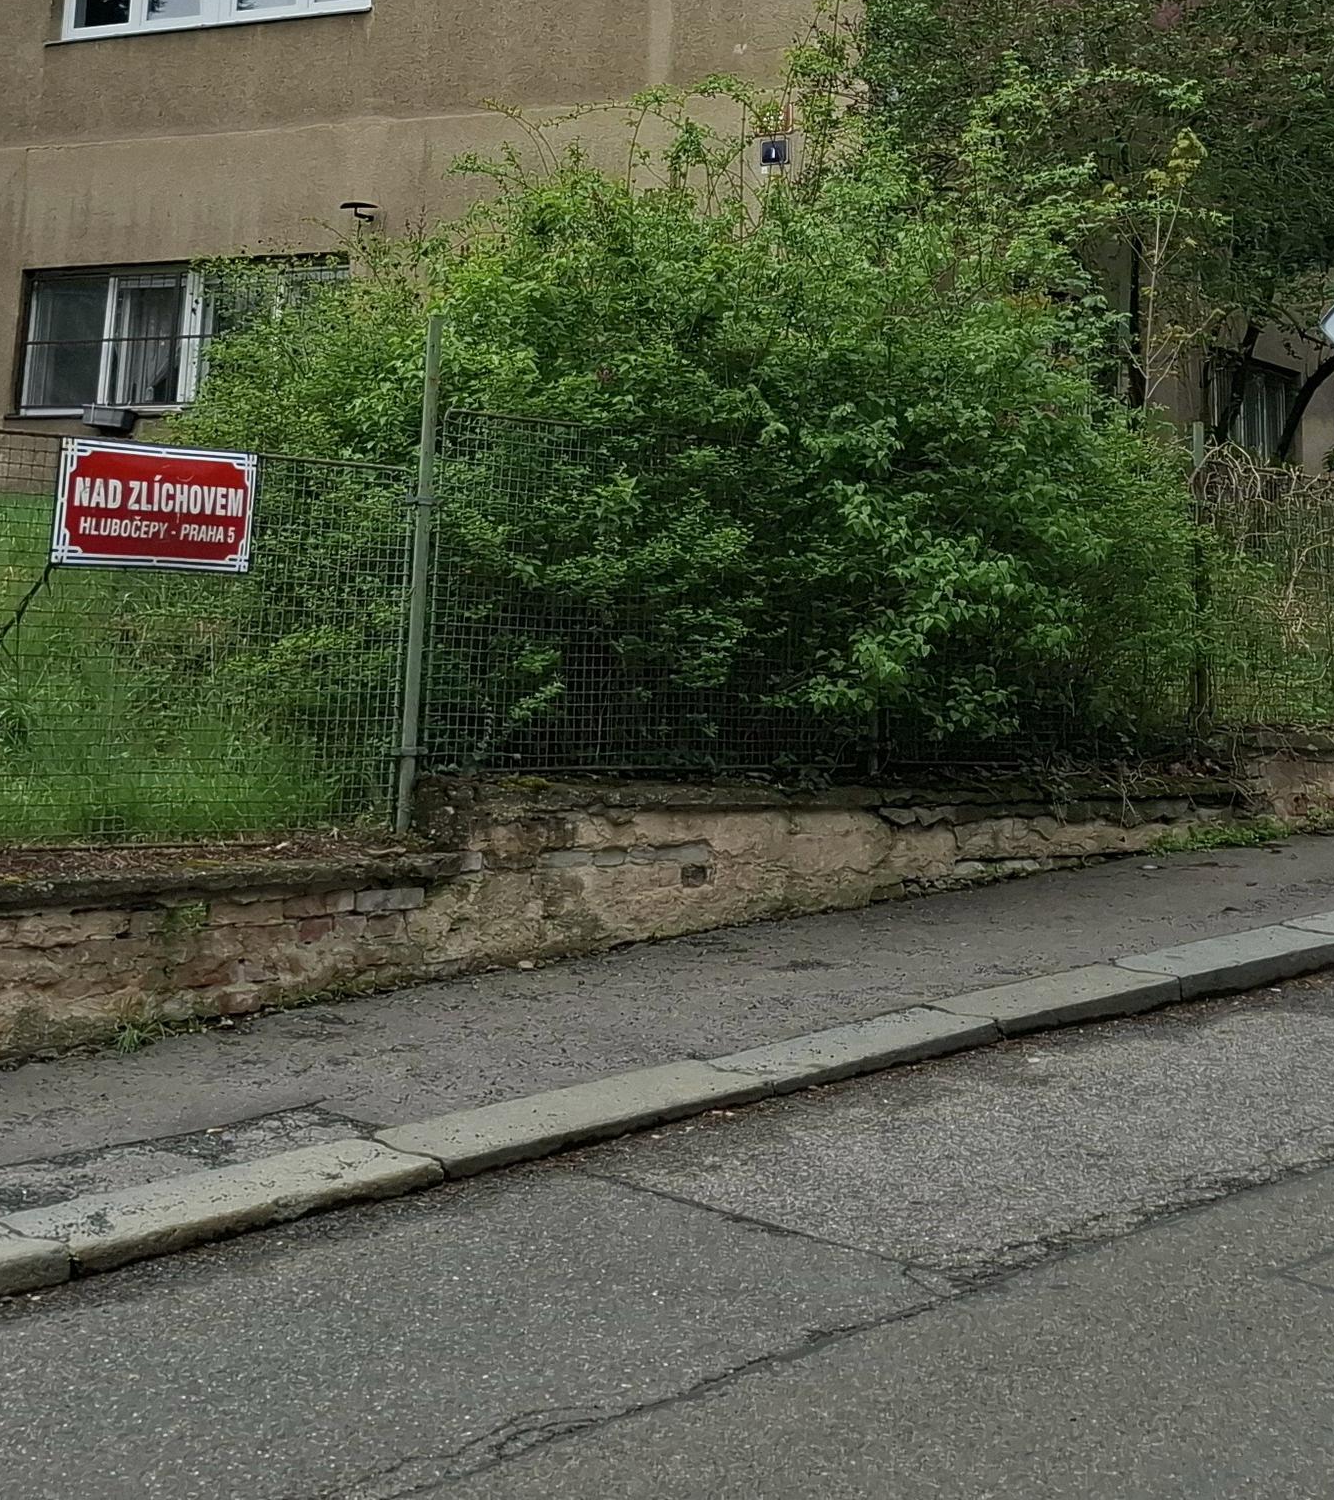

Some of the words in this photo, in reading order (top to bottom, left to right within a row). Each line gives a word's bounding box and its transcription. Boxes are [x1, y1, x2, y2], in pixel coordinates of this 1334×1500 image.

[74, 476, 123, 509] NAD
[127, 474, 244, 517] ZLÍCHOVEM
[79, 516, 169, 539] HLUBOČEPY
[179, 523, 225, 543] PRAHA
[227, 526, 236, 544] 5
